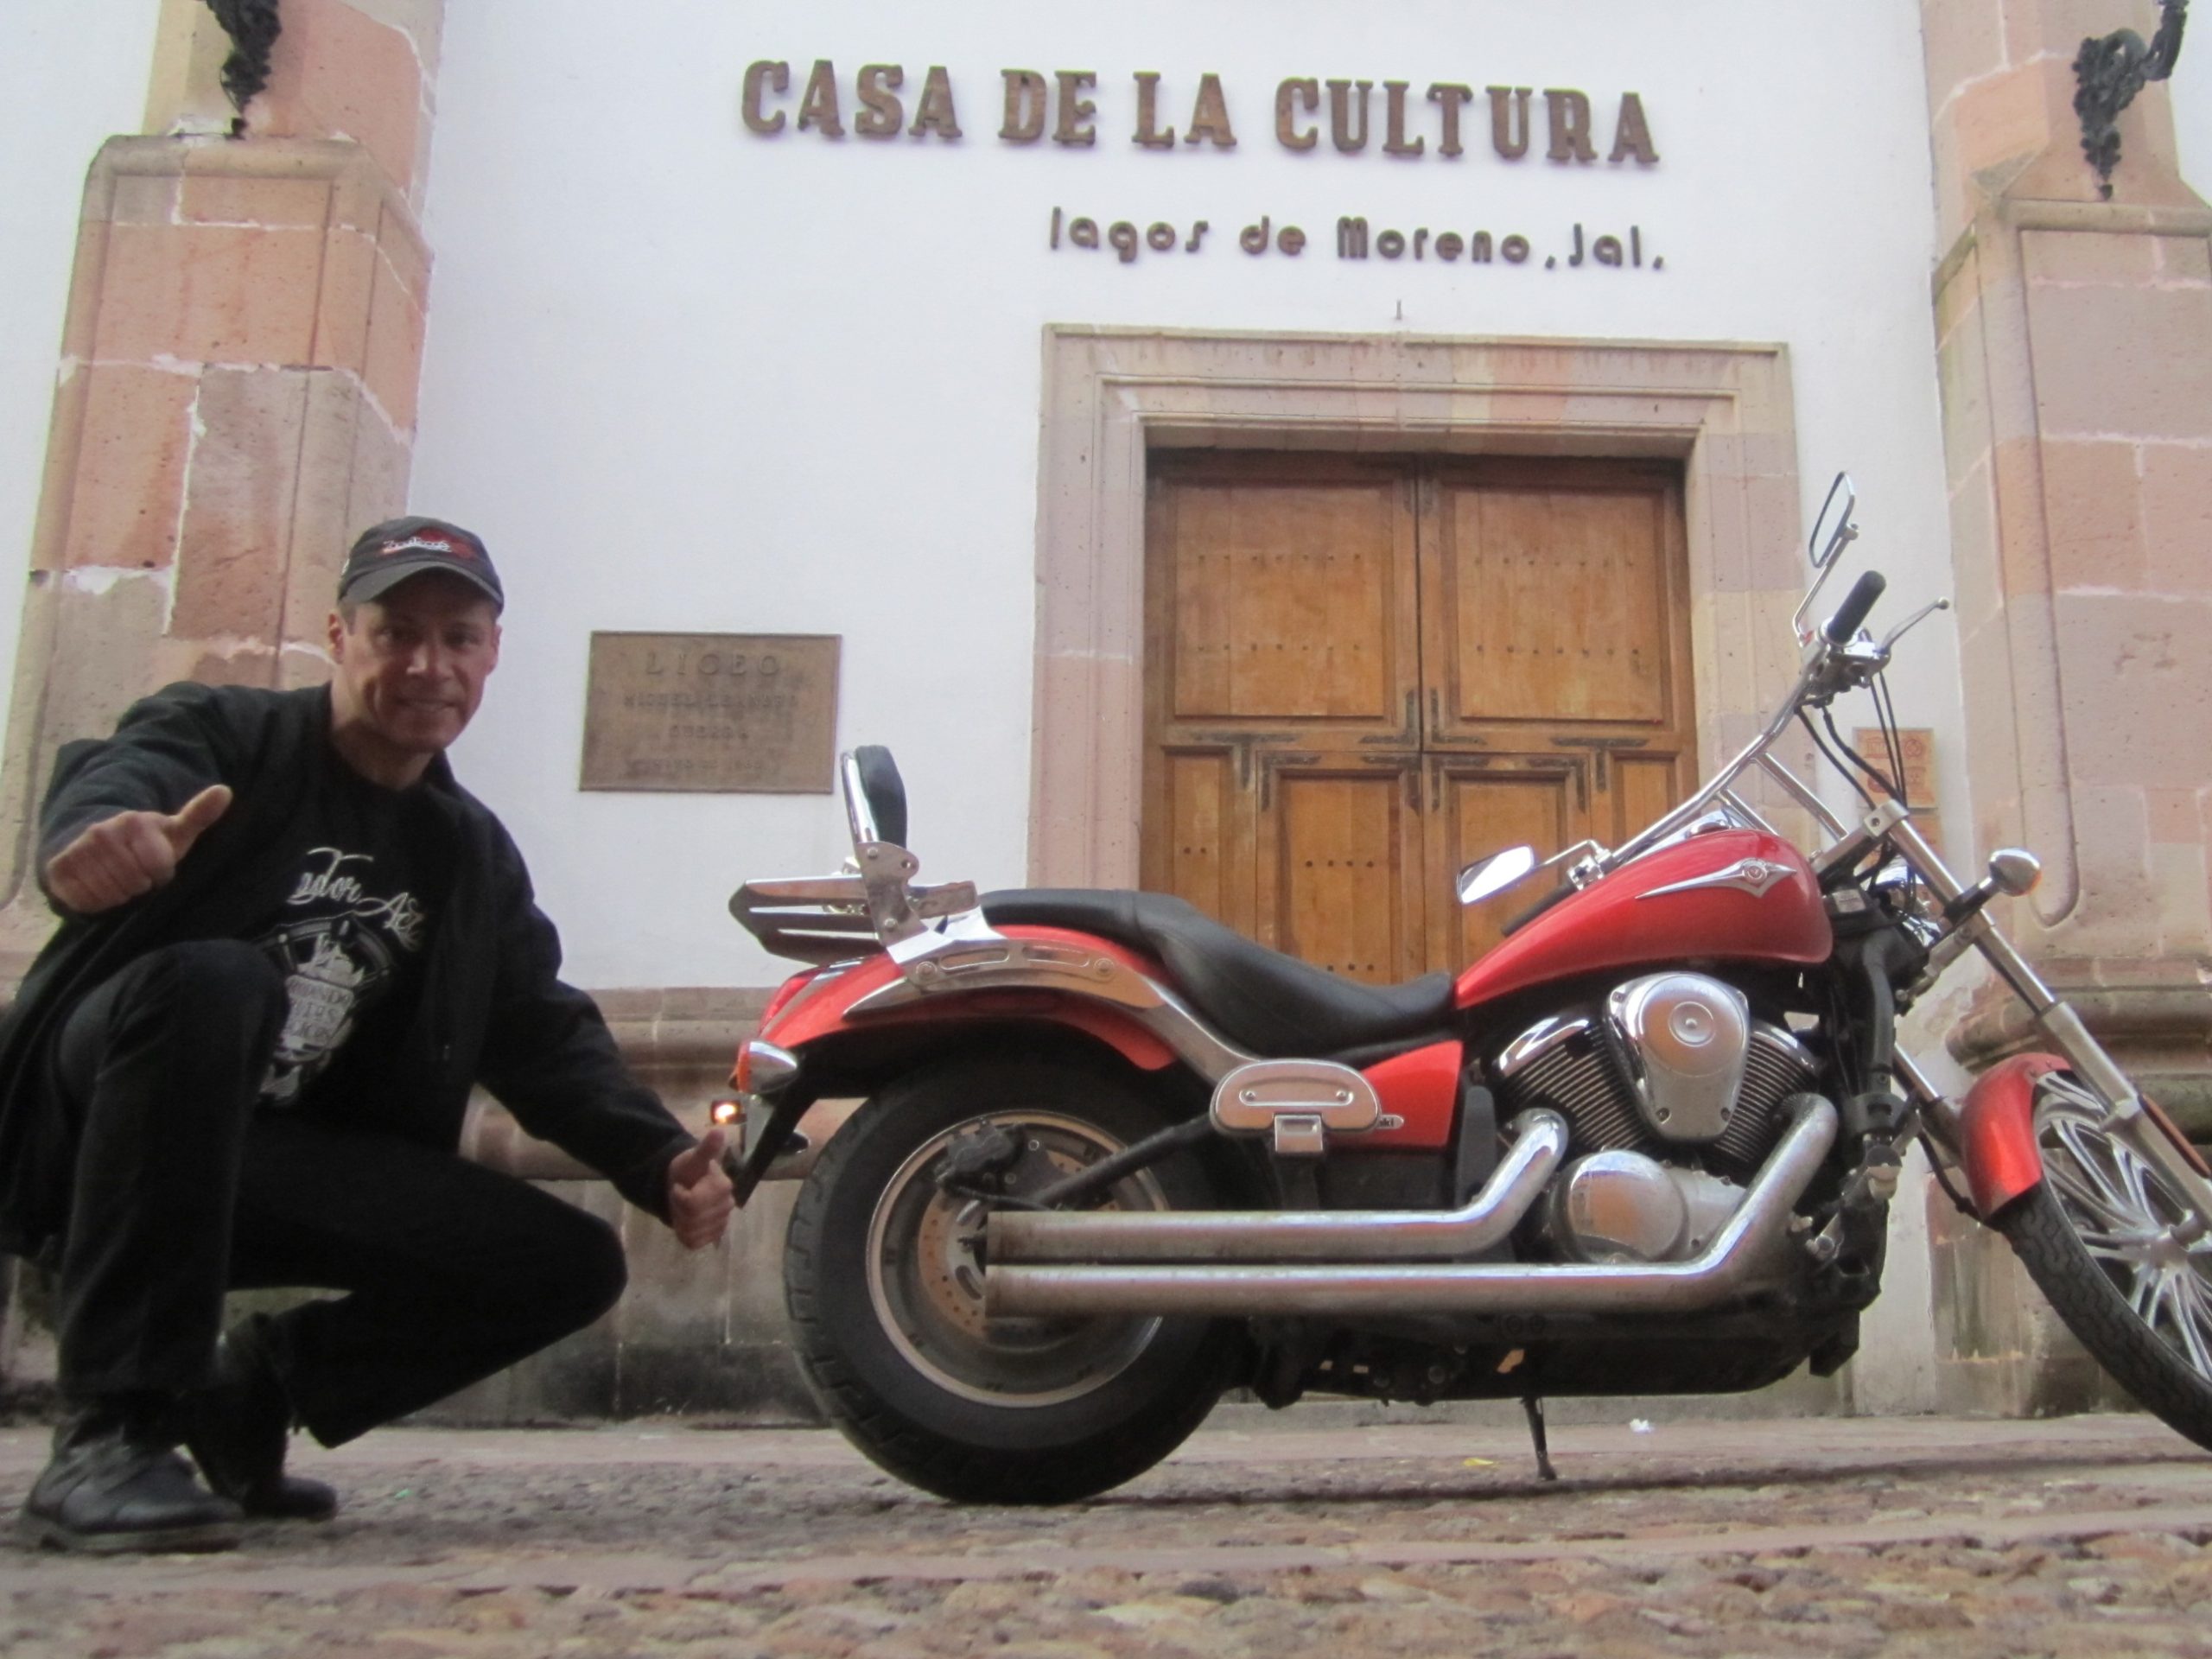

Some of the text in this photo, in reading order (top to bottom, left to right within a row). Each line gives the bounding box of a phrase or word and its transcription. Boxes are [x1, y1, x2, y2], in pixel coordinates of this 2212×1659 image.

[741, 59, 1662, 171] CASA DE LA CULTURA
[1239, 215, 1307, 258] de
